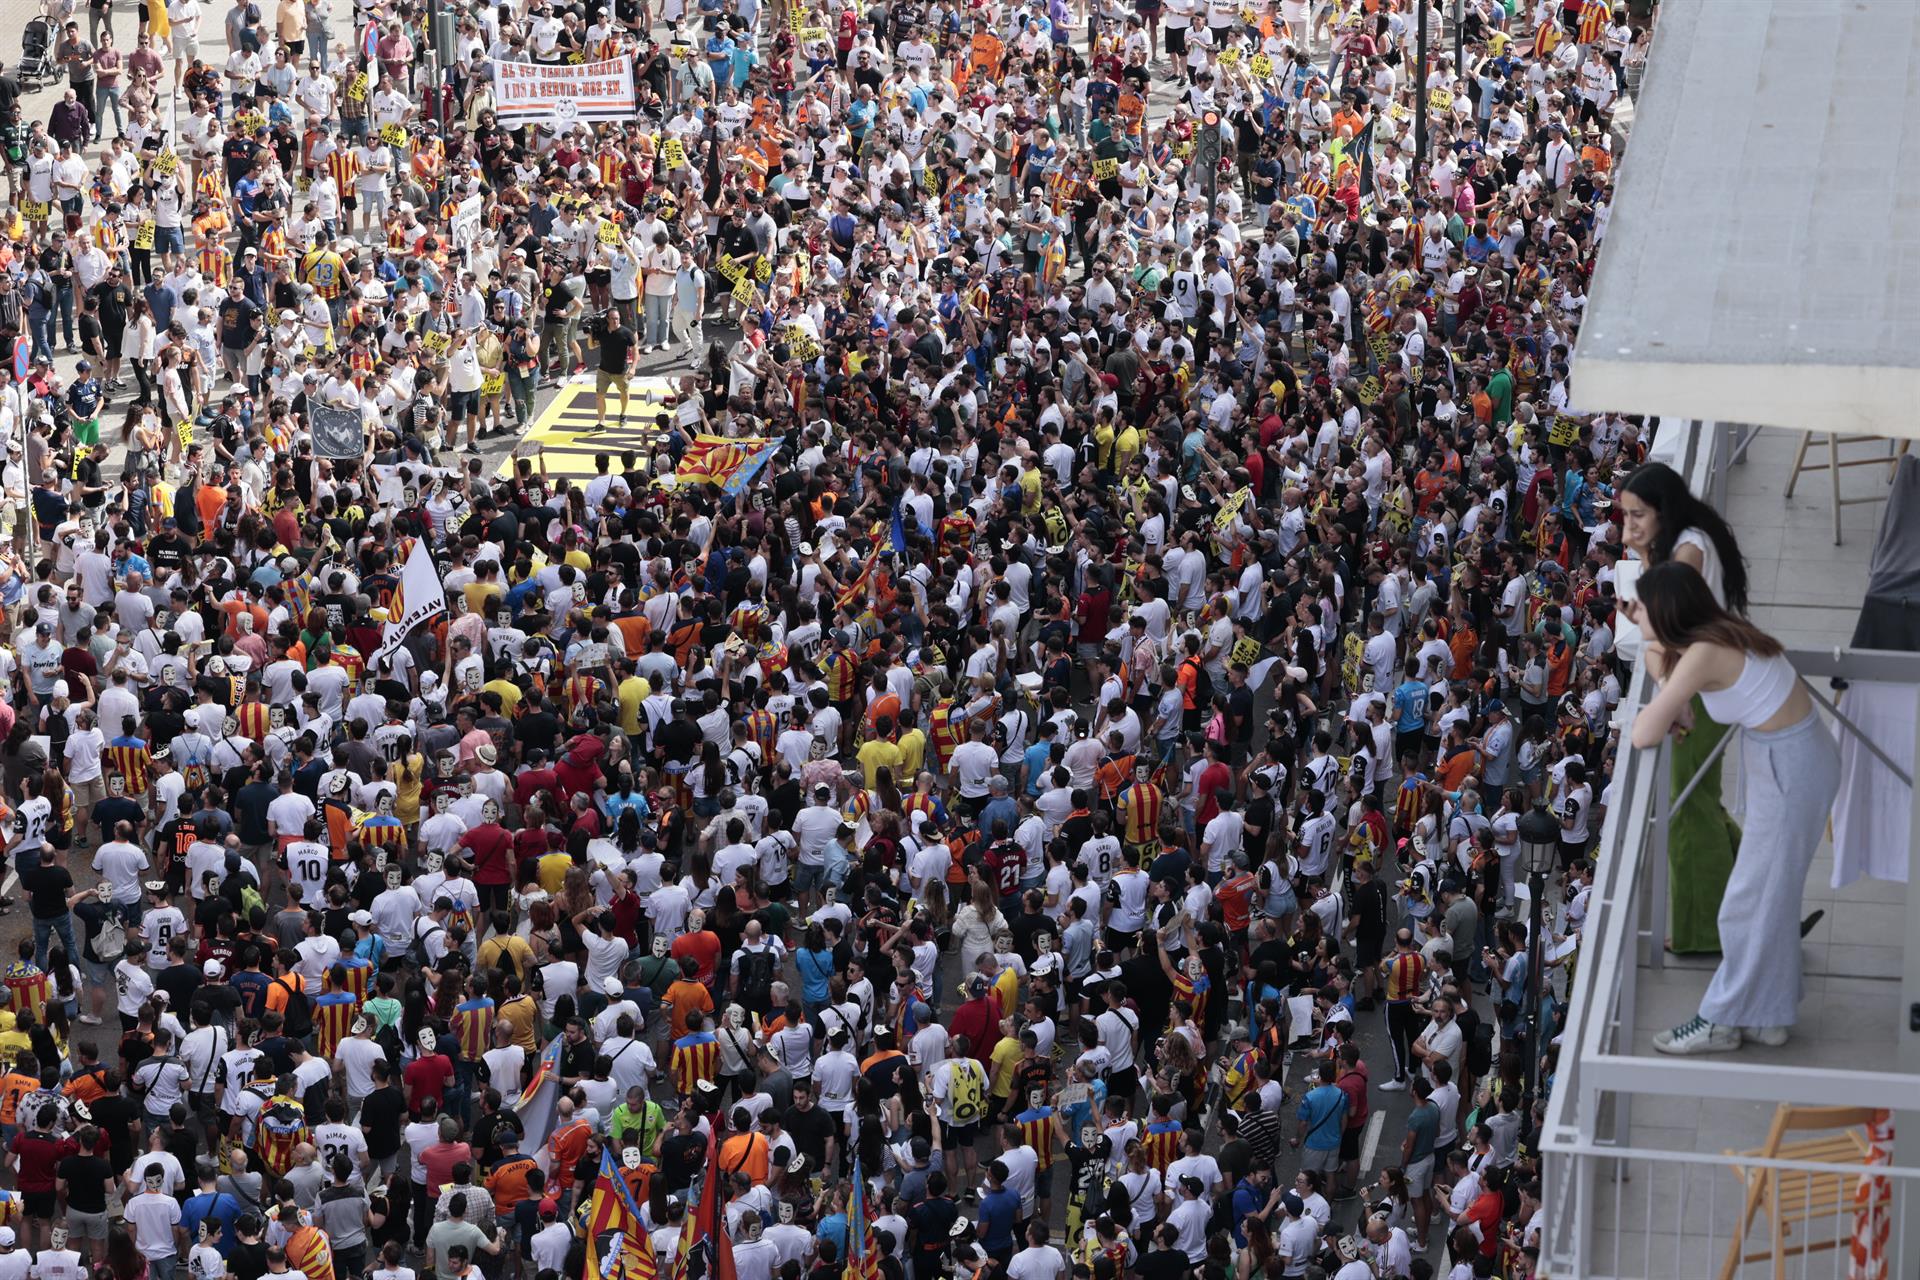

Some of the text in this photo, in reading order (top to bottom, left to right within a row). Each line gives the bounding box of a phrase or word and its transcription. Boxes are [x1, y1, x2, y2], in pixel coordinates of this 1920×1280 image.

[1219, 57, 1234, 67] HOME
[1255, 57, 1270, 65] LIM
[501, 63, 515, 78] AL
[541, 66, 575, 78] VENIM
[578, 68, 585, 77] A
[588, 60, 624, 76] SERVIR
[1250, 68, 1271, 78] HOME
[350, 73, 368, 97] HOME
[504, 84, 510, 99] I
[530, 83, 537, 98] A
[1433, 90, 1447, 99] LIM
[1430, 102, 1451, 111] HOME
[388, 123, 404, 133] LIM
[381, 134, 405, 147] HOME
[1169, 142, 1183, 150] LIM
[160, 152, 175, 162] LIM
[663, 141, 672, 168] HOME
[674, 144, 683, 161] LIM
[151, 162, 176, 174] HOME
[1095, 160, 1111, 168] LIM
[25, 201, 42, 209] LIM
[21, 212, 47, 220] HOME
[603, 222, 615, 232] LIM
[600, 234, 620, 245] HOME
[727, 258, 744, 270] LM
[315, 263, 333, 280] 13
[1177, 279, 1188, 297] 9
[431, 334, 448, 345] LIM
[794, 341, 810, 353] LIM
[799, 348, 808, 356] GO
[1368, 336, 1385, 364] HOME
[801, 349, 820, 363] OME
[480, 383, 501, 395] HME
[1360, 380, 1373, 398] LIM
[1551, 417, 1562, 438] LIM
[1559, 424, 1566, 434] GO
[1563, 422, 1575, 447] HOM
[1598, 438, 1617, 446] bwin
[500, 644, 512, 661] 6
[802, 639, 819, 661] 19
[1231, 642, 1247, 663] LIM
[1240, 650, 1248, 661] GO
[1246, 643, 1260, 666] OME
[32, 661, 56, 669] bwin
[1413, 698, 1424, 720] 19
[1323, 769, 1337, 795] 10
[618, 802, 637, 811] AIMAR
[745, 804, 760, 812] HUGO
[175, 832, 198, 854] 18
[1319, 832, 1330, 855] 6
[297, 848, 319, 856] MARCO
[1096, 845, 1112, 854] SERGI
[1099, 852, 1111, 874] 8
[296, 859, 321, 882] 10
[1000, 864, 1020, 889] 21
[159, 925, 172, 947] 9
[212, 948, 233, 957] SERGIO
[243, 992, 256, 1014] 7
[234, 1058, 248, 1068] HUGO
[10, 1088, 20, 1108] 1
[325, 1132, 347, 1141] AIMAR
[323, 1143, 348, 1165] 21
[507, 1164, 530, 1174] MAROTO
[630, 1178, 643, 1202] 7
